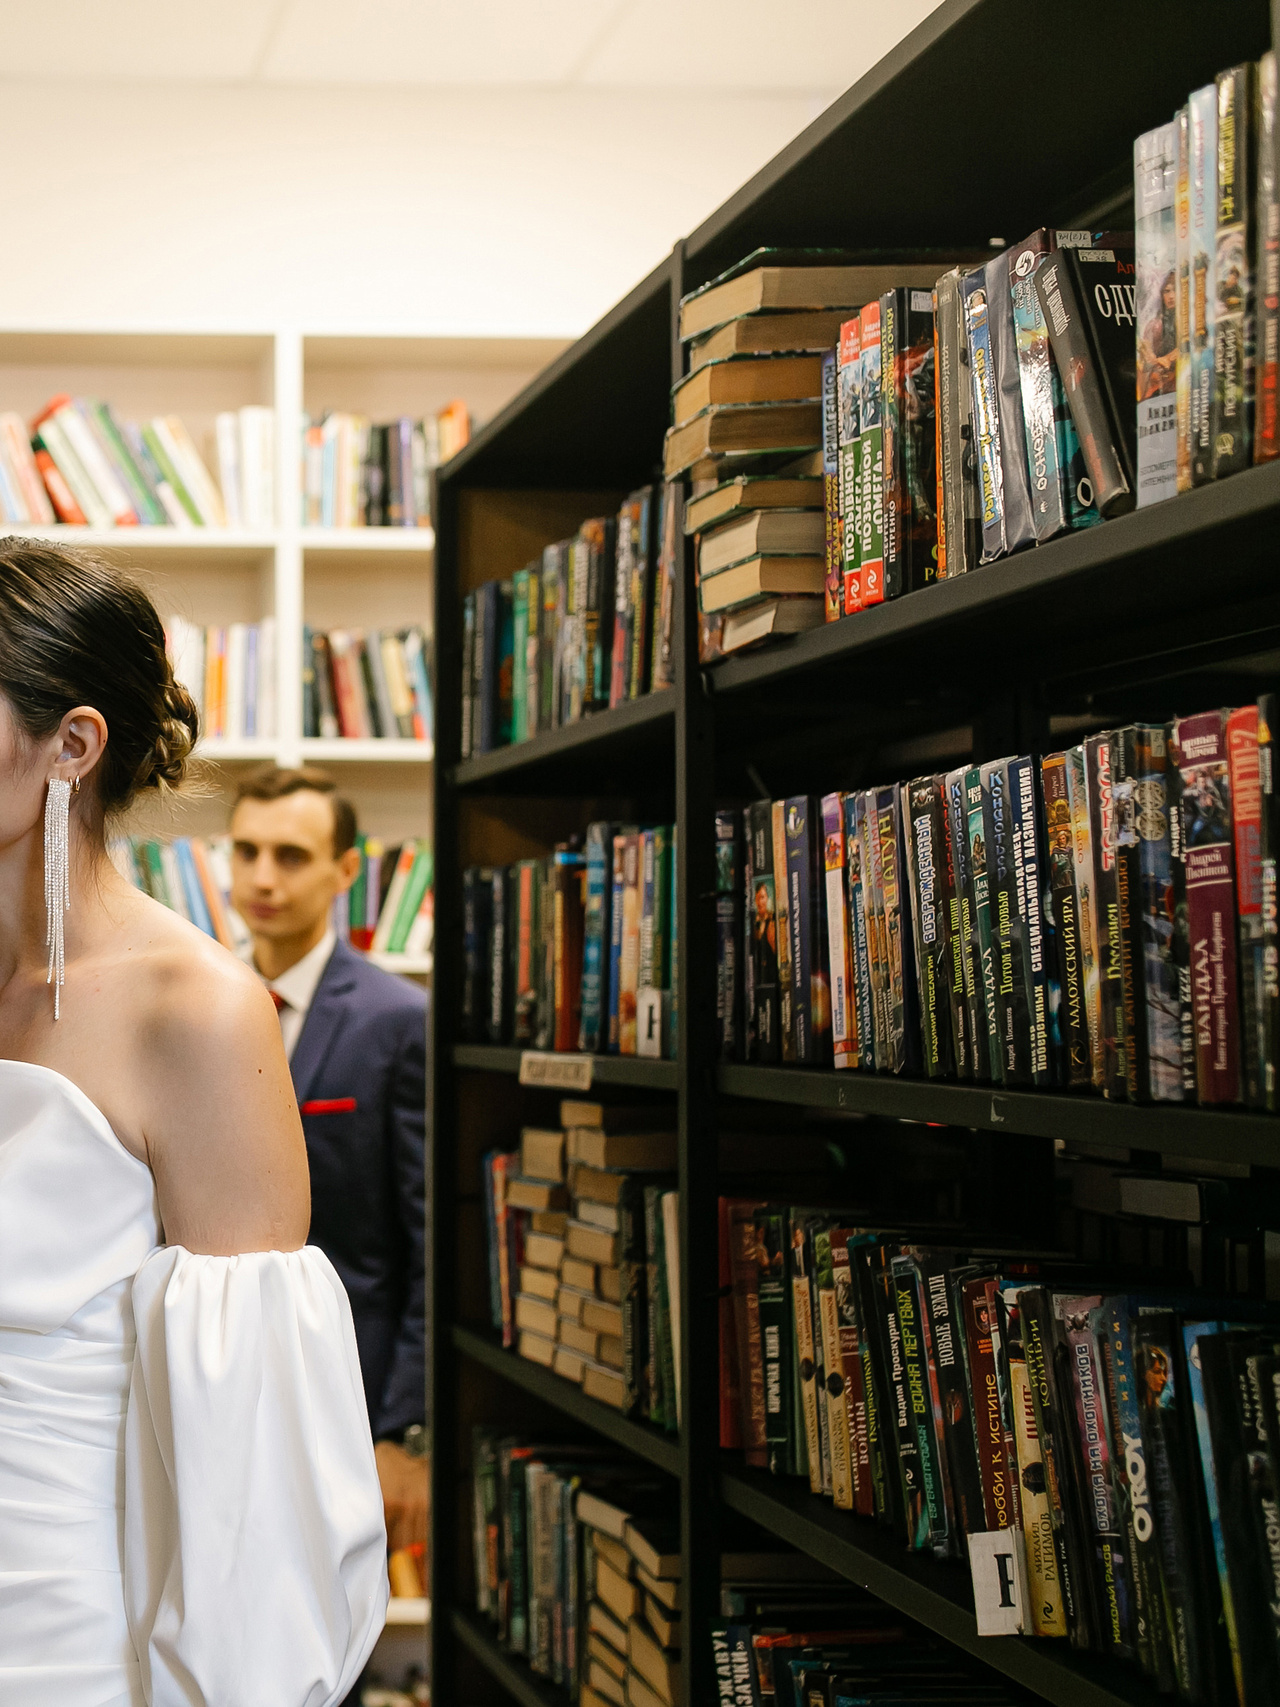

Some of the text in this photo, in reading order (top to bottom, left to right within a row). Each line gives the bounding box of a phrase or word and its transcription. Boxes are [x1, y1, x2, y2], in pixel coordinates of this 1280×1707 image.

[884, 306, 895, 403] РОЗОВЫЕ ОЧКИ
[1224, 328, 1237, 417] ПОДГУРСКИЙ
[825, 362, 838, 463] АРМАГЕДДОН
[1200, 368, 1209, 448] ПЛОТНИКОВ
[843, 450, 855, 562] ПОЗЫВНОЙ
[861, 438, 873, 552] ПОЗЫВНОЙ
[871, 450, 883, 535] «ОМЕГА»
[888, 499, 897, 563] ПЕТРЕНКО
[880, 815, 896, 907] ШАТУН
[914, 813, 938, 944] ВОЗРОЖДЕННЫЙ
[1012, 822, 1026, 923] «ПОПАДАНЕЦ»
[1019, 766, 1043, 973] СПЕЦИАЛЬНОГО НАЗНАЧЕНИЯ
[959, 897, 972, 941] кровью
[997, 890, 1012, 935] кровью
[1210, 911, 1225, 963] Карфагена
[858, 948, 873, 1046] ГРЮНВАЛЬДСКОЕ
[950, 933, 964, 994] Ливонский
[964, 958, 976, 997] Потом
[982, 946, 997, 1036] ВАНДАЛ
[998, 952, 1014, 996] Потом
[1061, 894, 1081, 1029] ЛАДОЖСКИЙ ЯРЛ
[1195, 938, 1212, 1046] ВАНДАЛ
[1211, 965, 1227, 1004] Призрак
[1004, 1006, 1015, 1071] Андрей Посняков
[898, 1289, 926, 1414] ВОЙНА МЕРТВЫХ
[929, 1273, 955, 1367] НОВЫЕ ЗЕМЛИ
[1027, 1342, 1039, 1387] ИГРА
[1030, 1318, 1050, 1407] КОЛИБРИ
[886, 1312, 907, 1428] Вадим Проскурин
[855, 1401, 868, 1465] ВОЙНЫ
[918, 1424, 937, 1519] ЕВГЕНИЙ ПРОШКИН
[1076, 1343, 1110, 1531] ОХОТА НА ОХОТНИКОВ
[1031, 1521, 1041, 1574] МИХАИЛ
[1040, 1512, 1056, 1581] РАГИМОВ
[1100, 1542, 1123, 1644] НИКОЛАЙ РАКОВ
